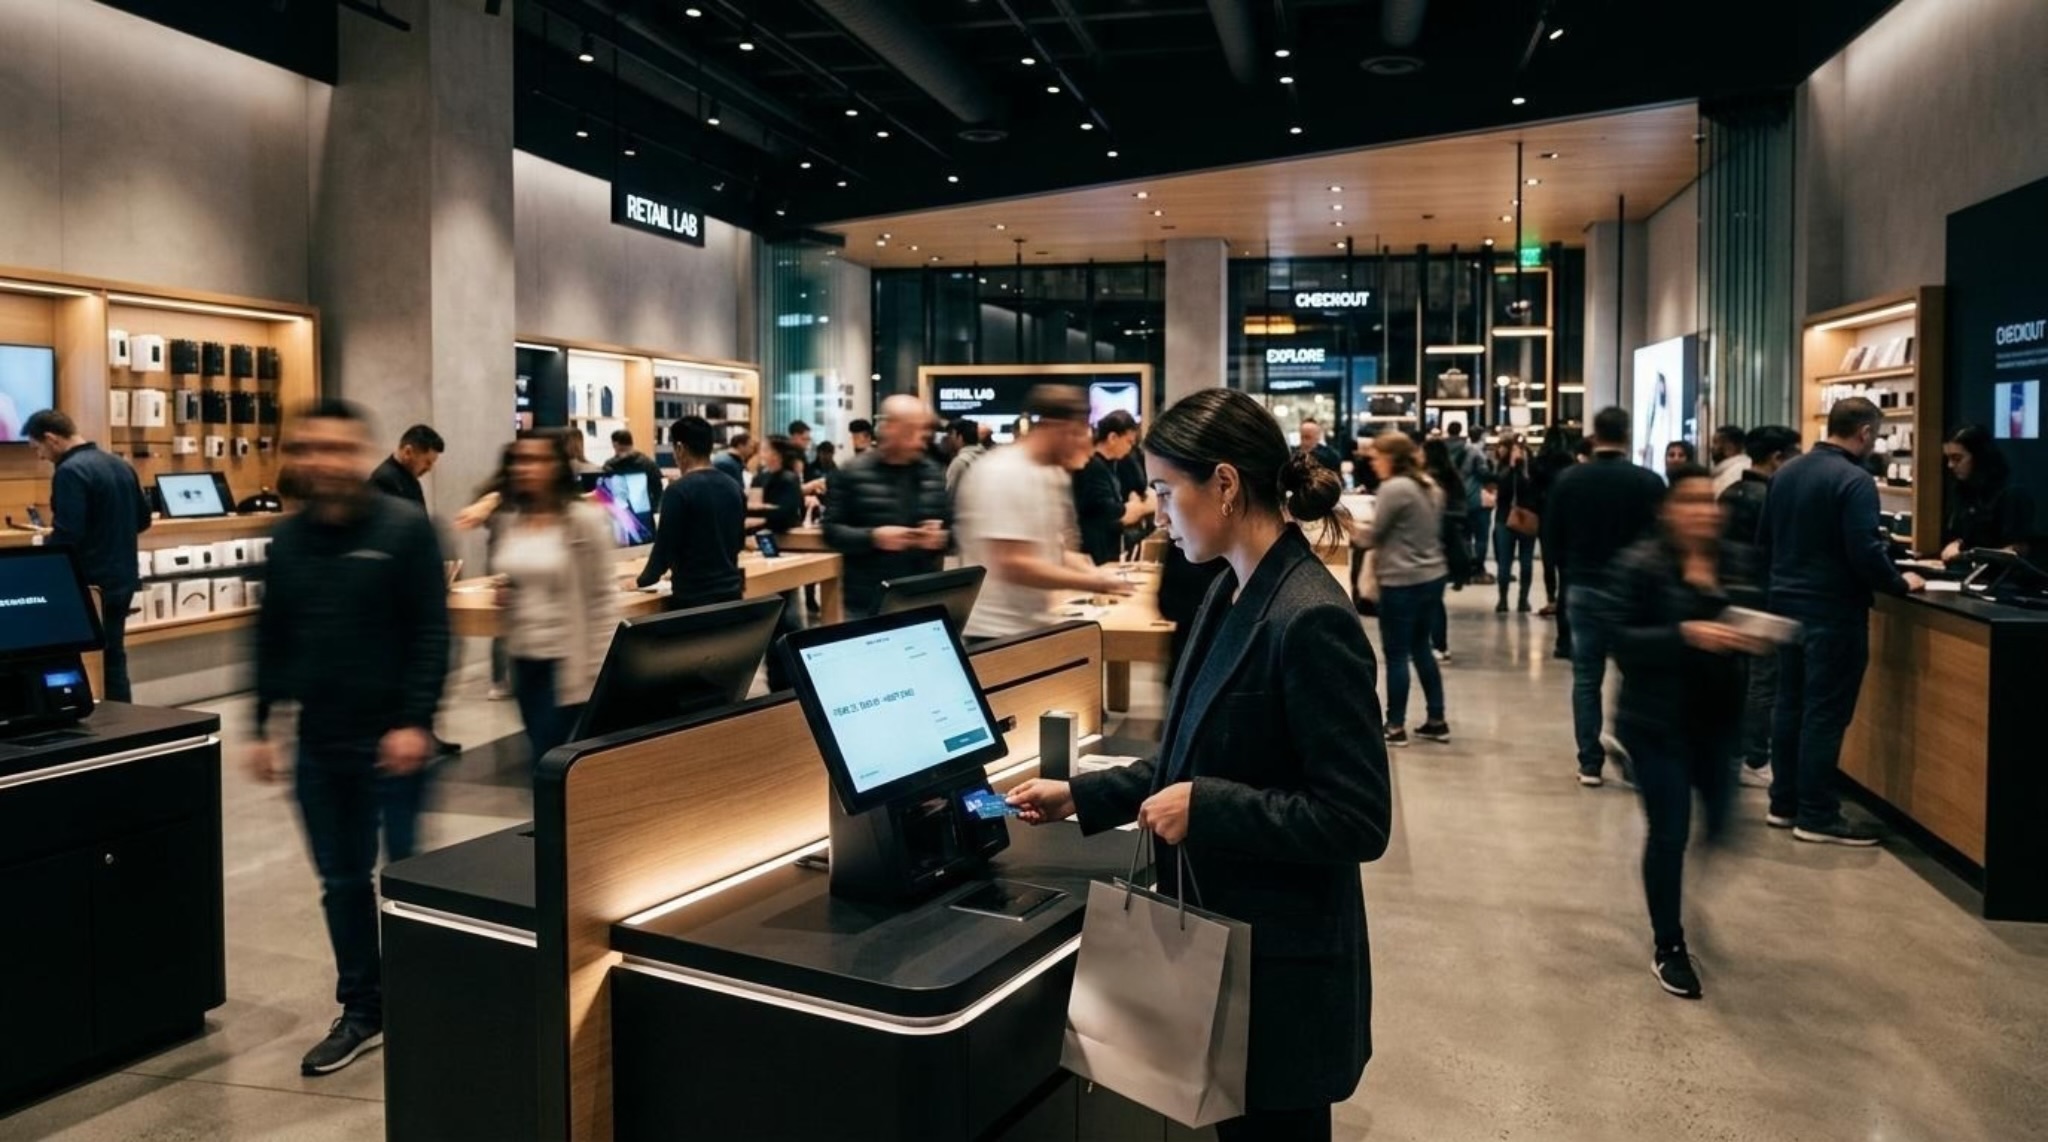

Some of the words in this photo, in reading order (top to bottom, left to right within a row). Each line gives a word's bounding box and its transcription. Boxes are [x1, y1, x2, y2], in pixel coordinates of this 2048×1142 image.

[627, 194, 672, 230] RETAIL
[673, 208, 698, 237] LAB
[1295, 291, 1370, 308] CHECKOUT
[1266, 348, 1326, 363] EXPLORE
